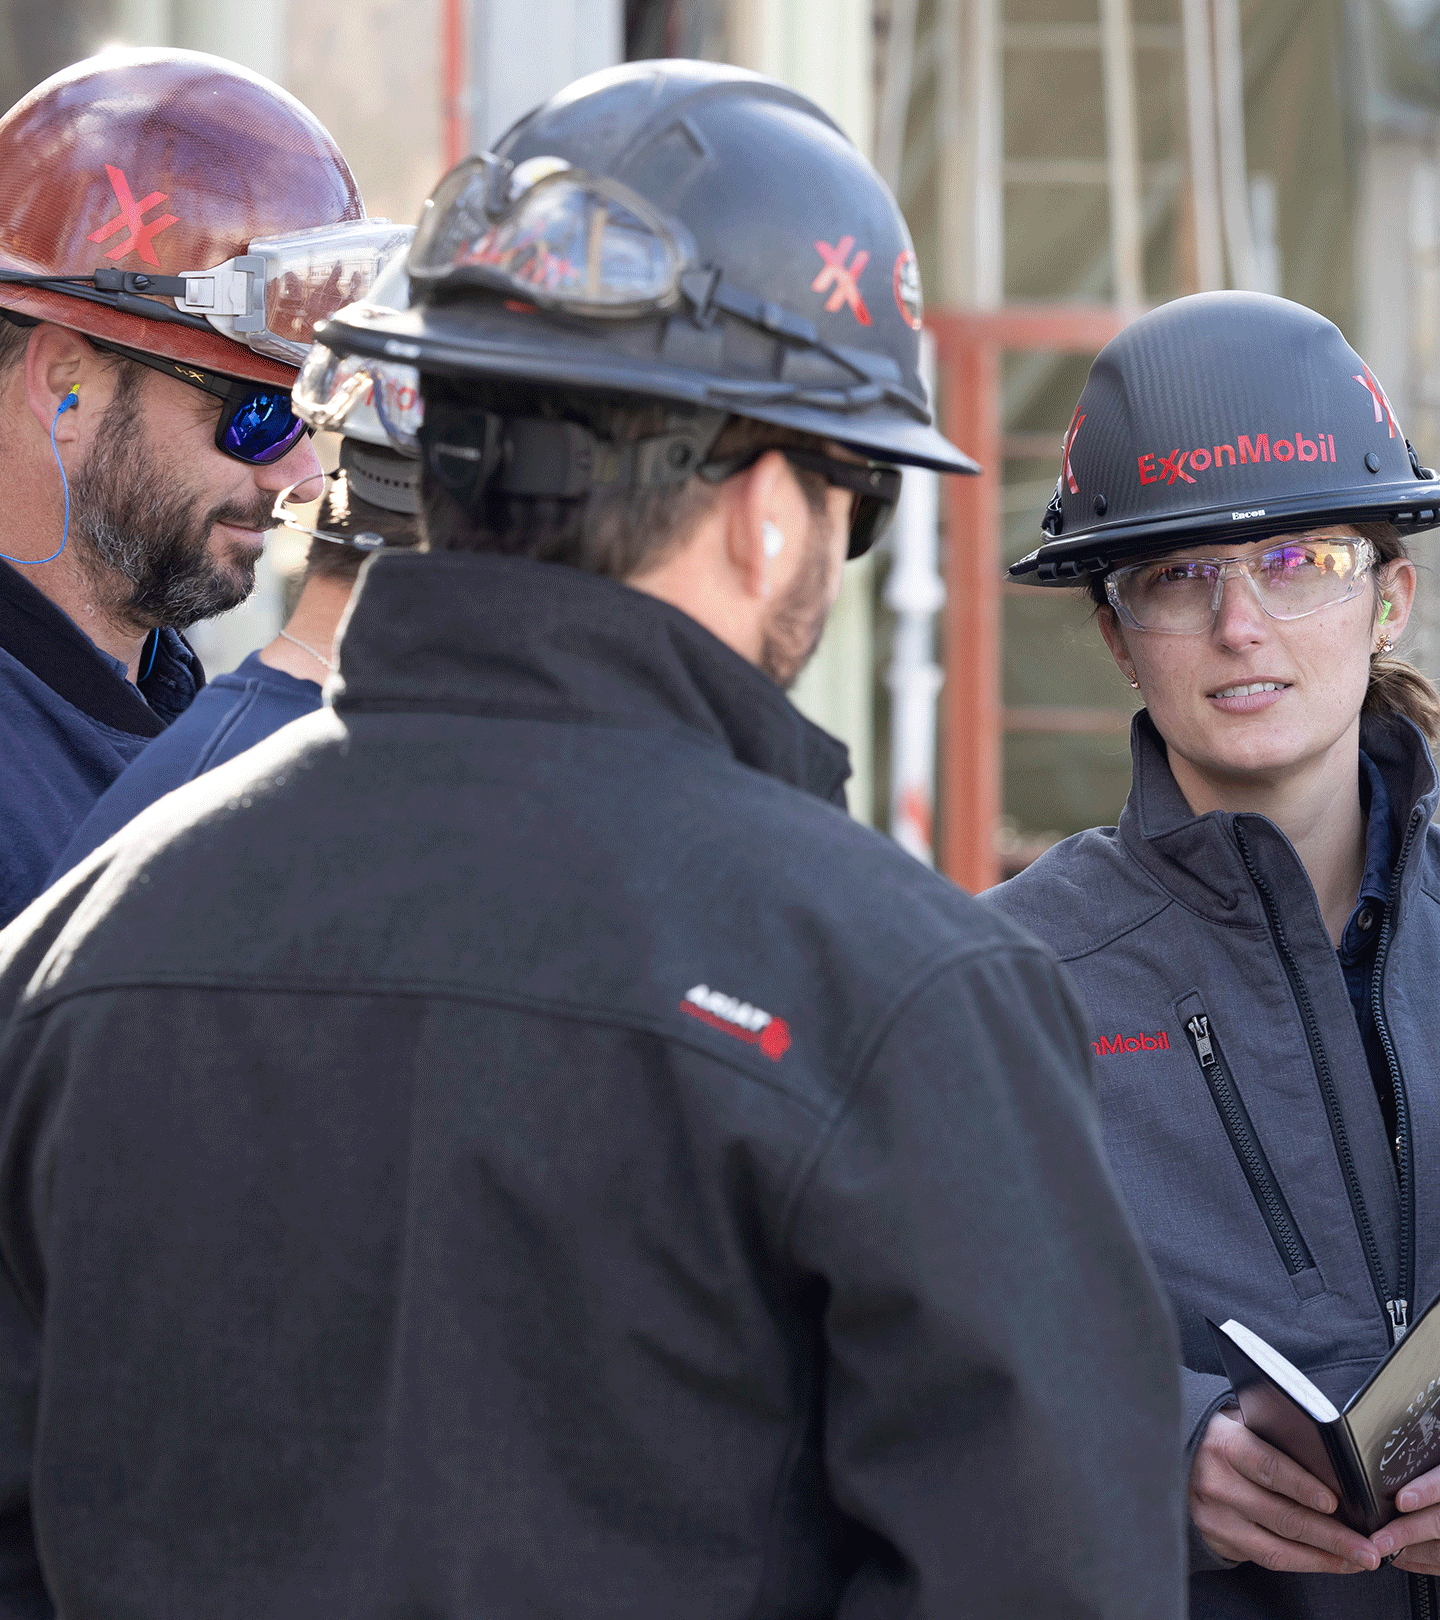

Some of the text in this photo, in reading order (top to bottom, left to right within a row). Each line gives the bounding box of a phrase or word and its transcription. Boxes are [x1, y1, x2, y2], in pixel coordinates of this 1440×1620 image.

[1137, 432, 1337, 486] ExxonMobil
[1231, 509, 1266, 521] Encon
[1090, 1030, 1170, 1056] nMobil
